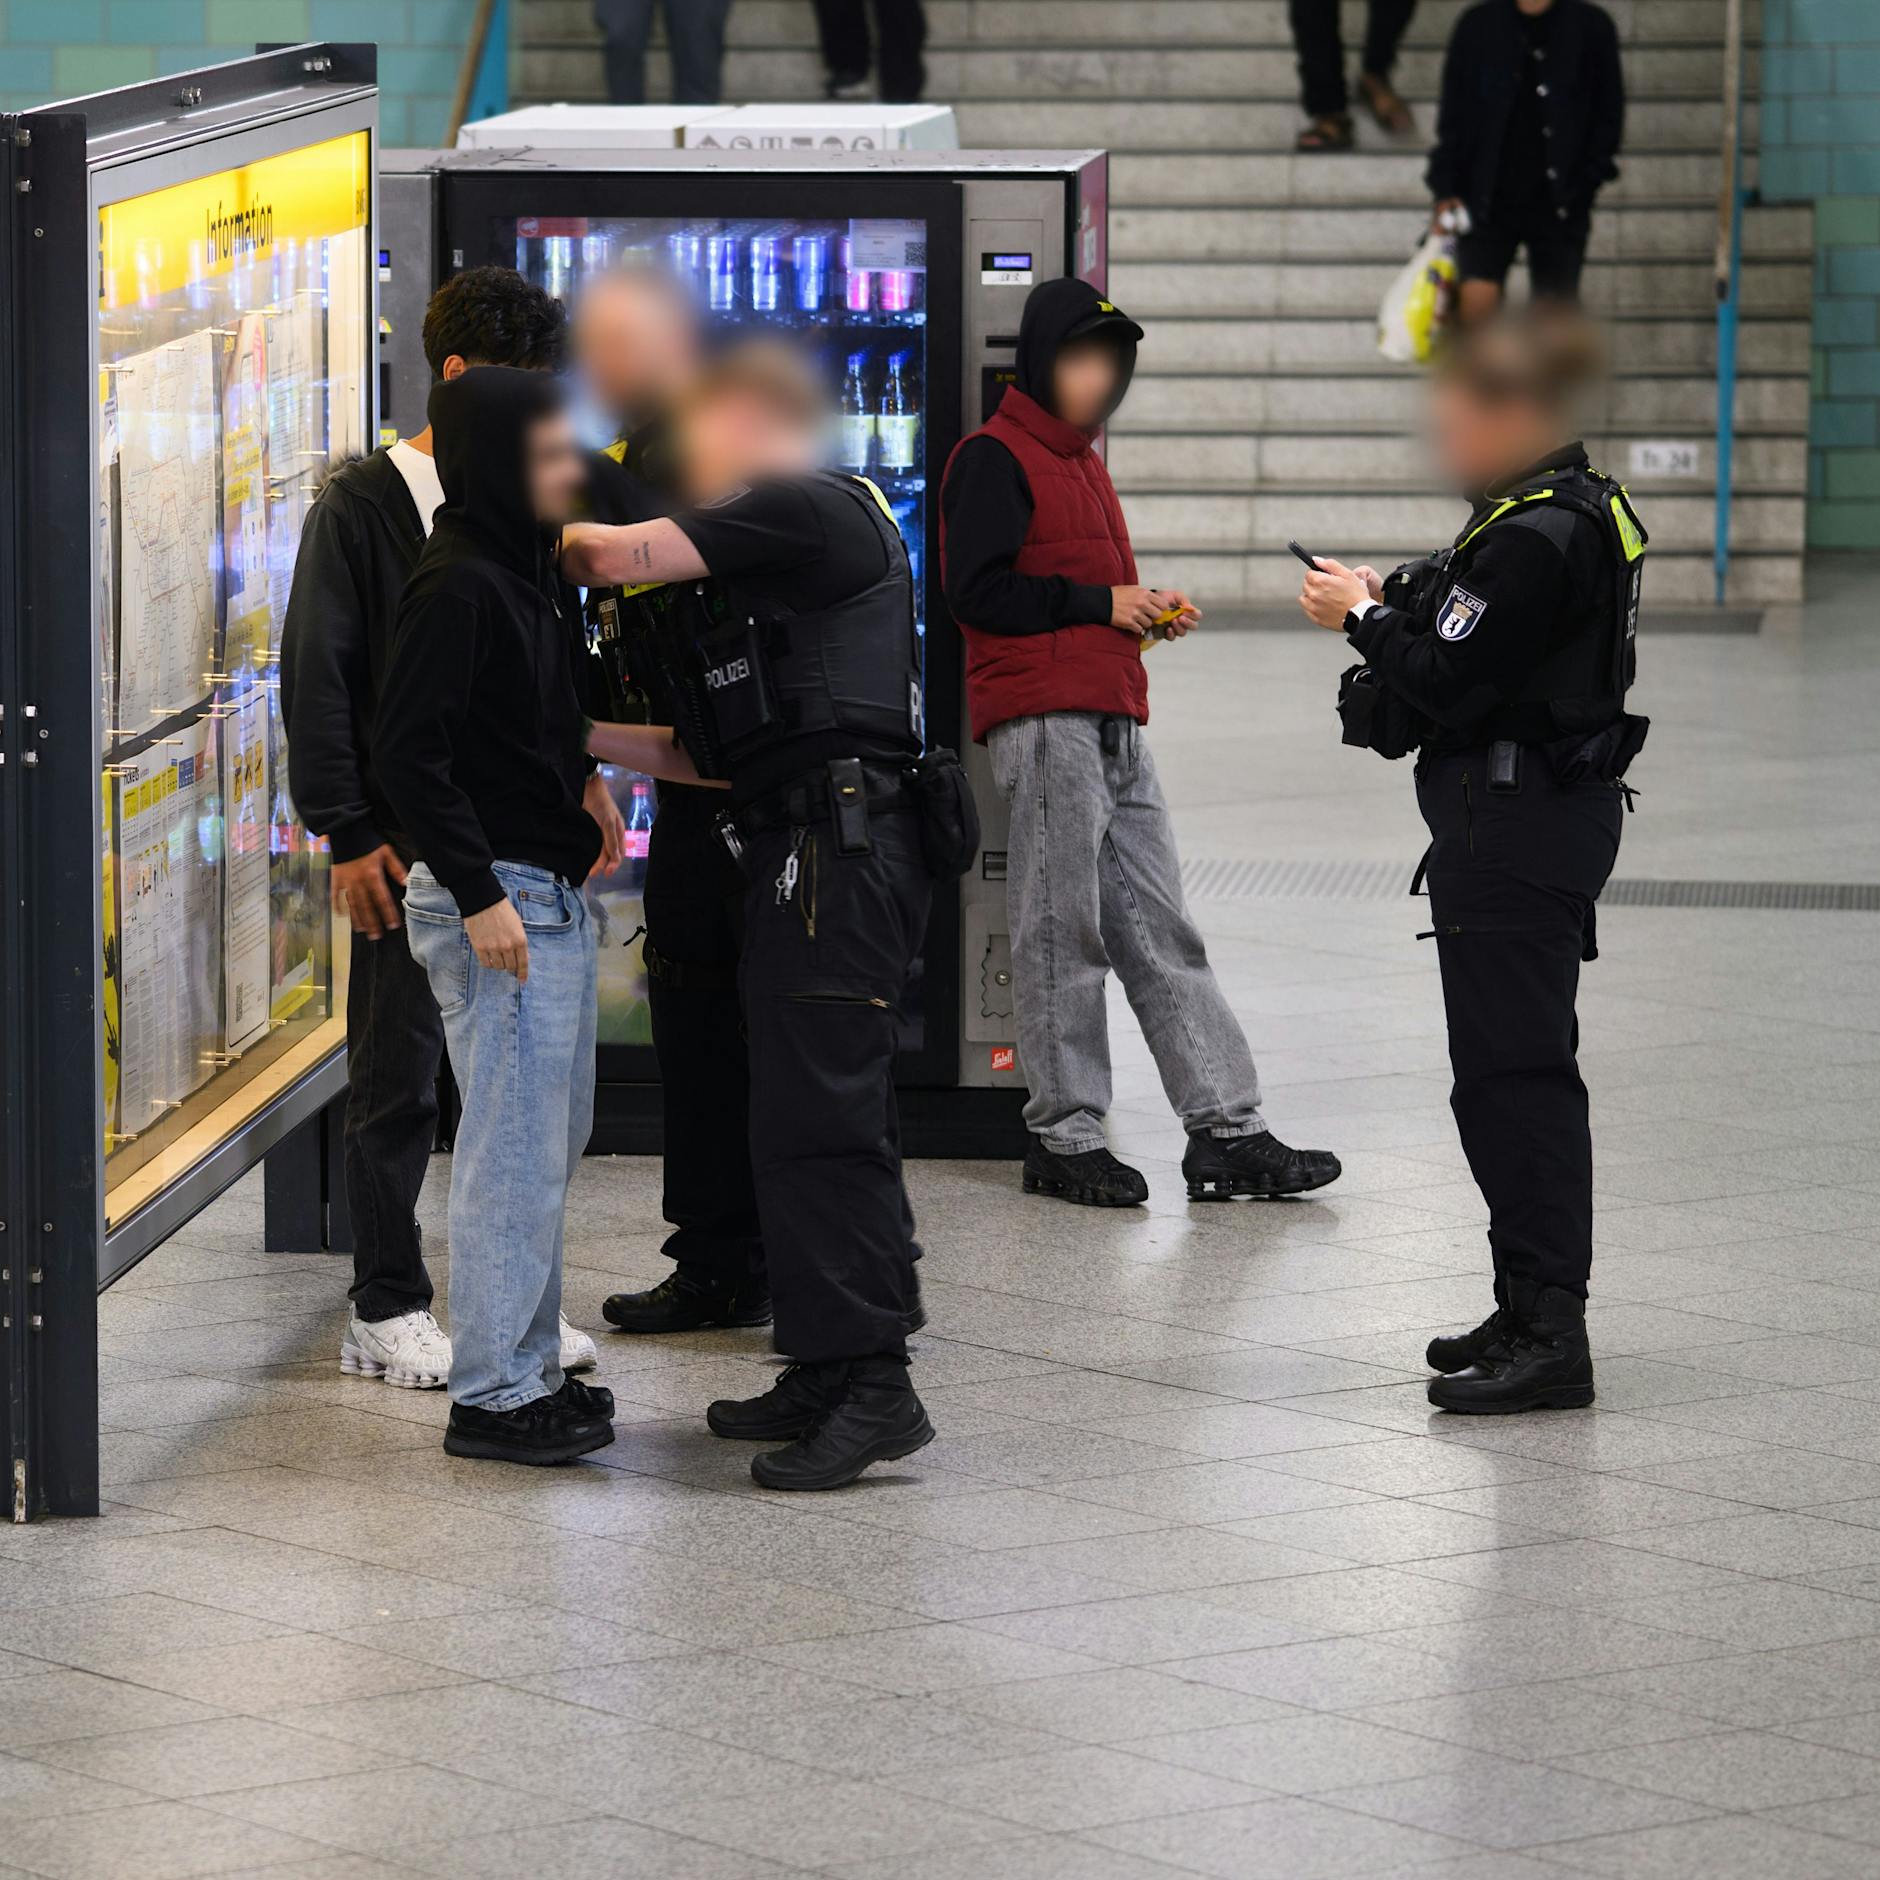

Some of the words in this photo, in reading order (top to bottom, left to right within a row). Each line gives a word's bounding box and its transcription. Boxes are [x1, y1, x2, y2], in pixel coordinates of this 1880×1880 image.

[206, 191, 274, 265] Information
[1452, 588, 1483, 613] POLIZEI
[704, 657, 750, 692] POLIZEI
